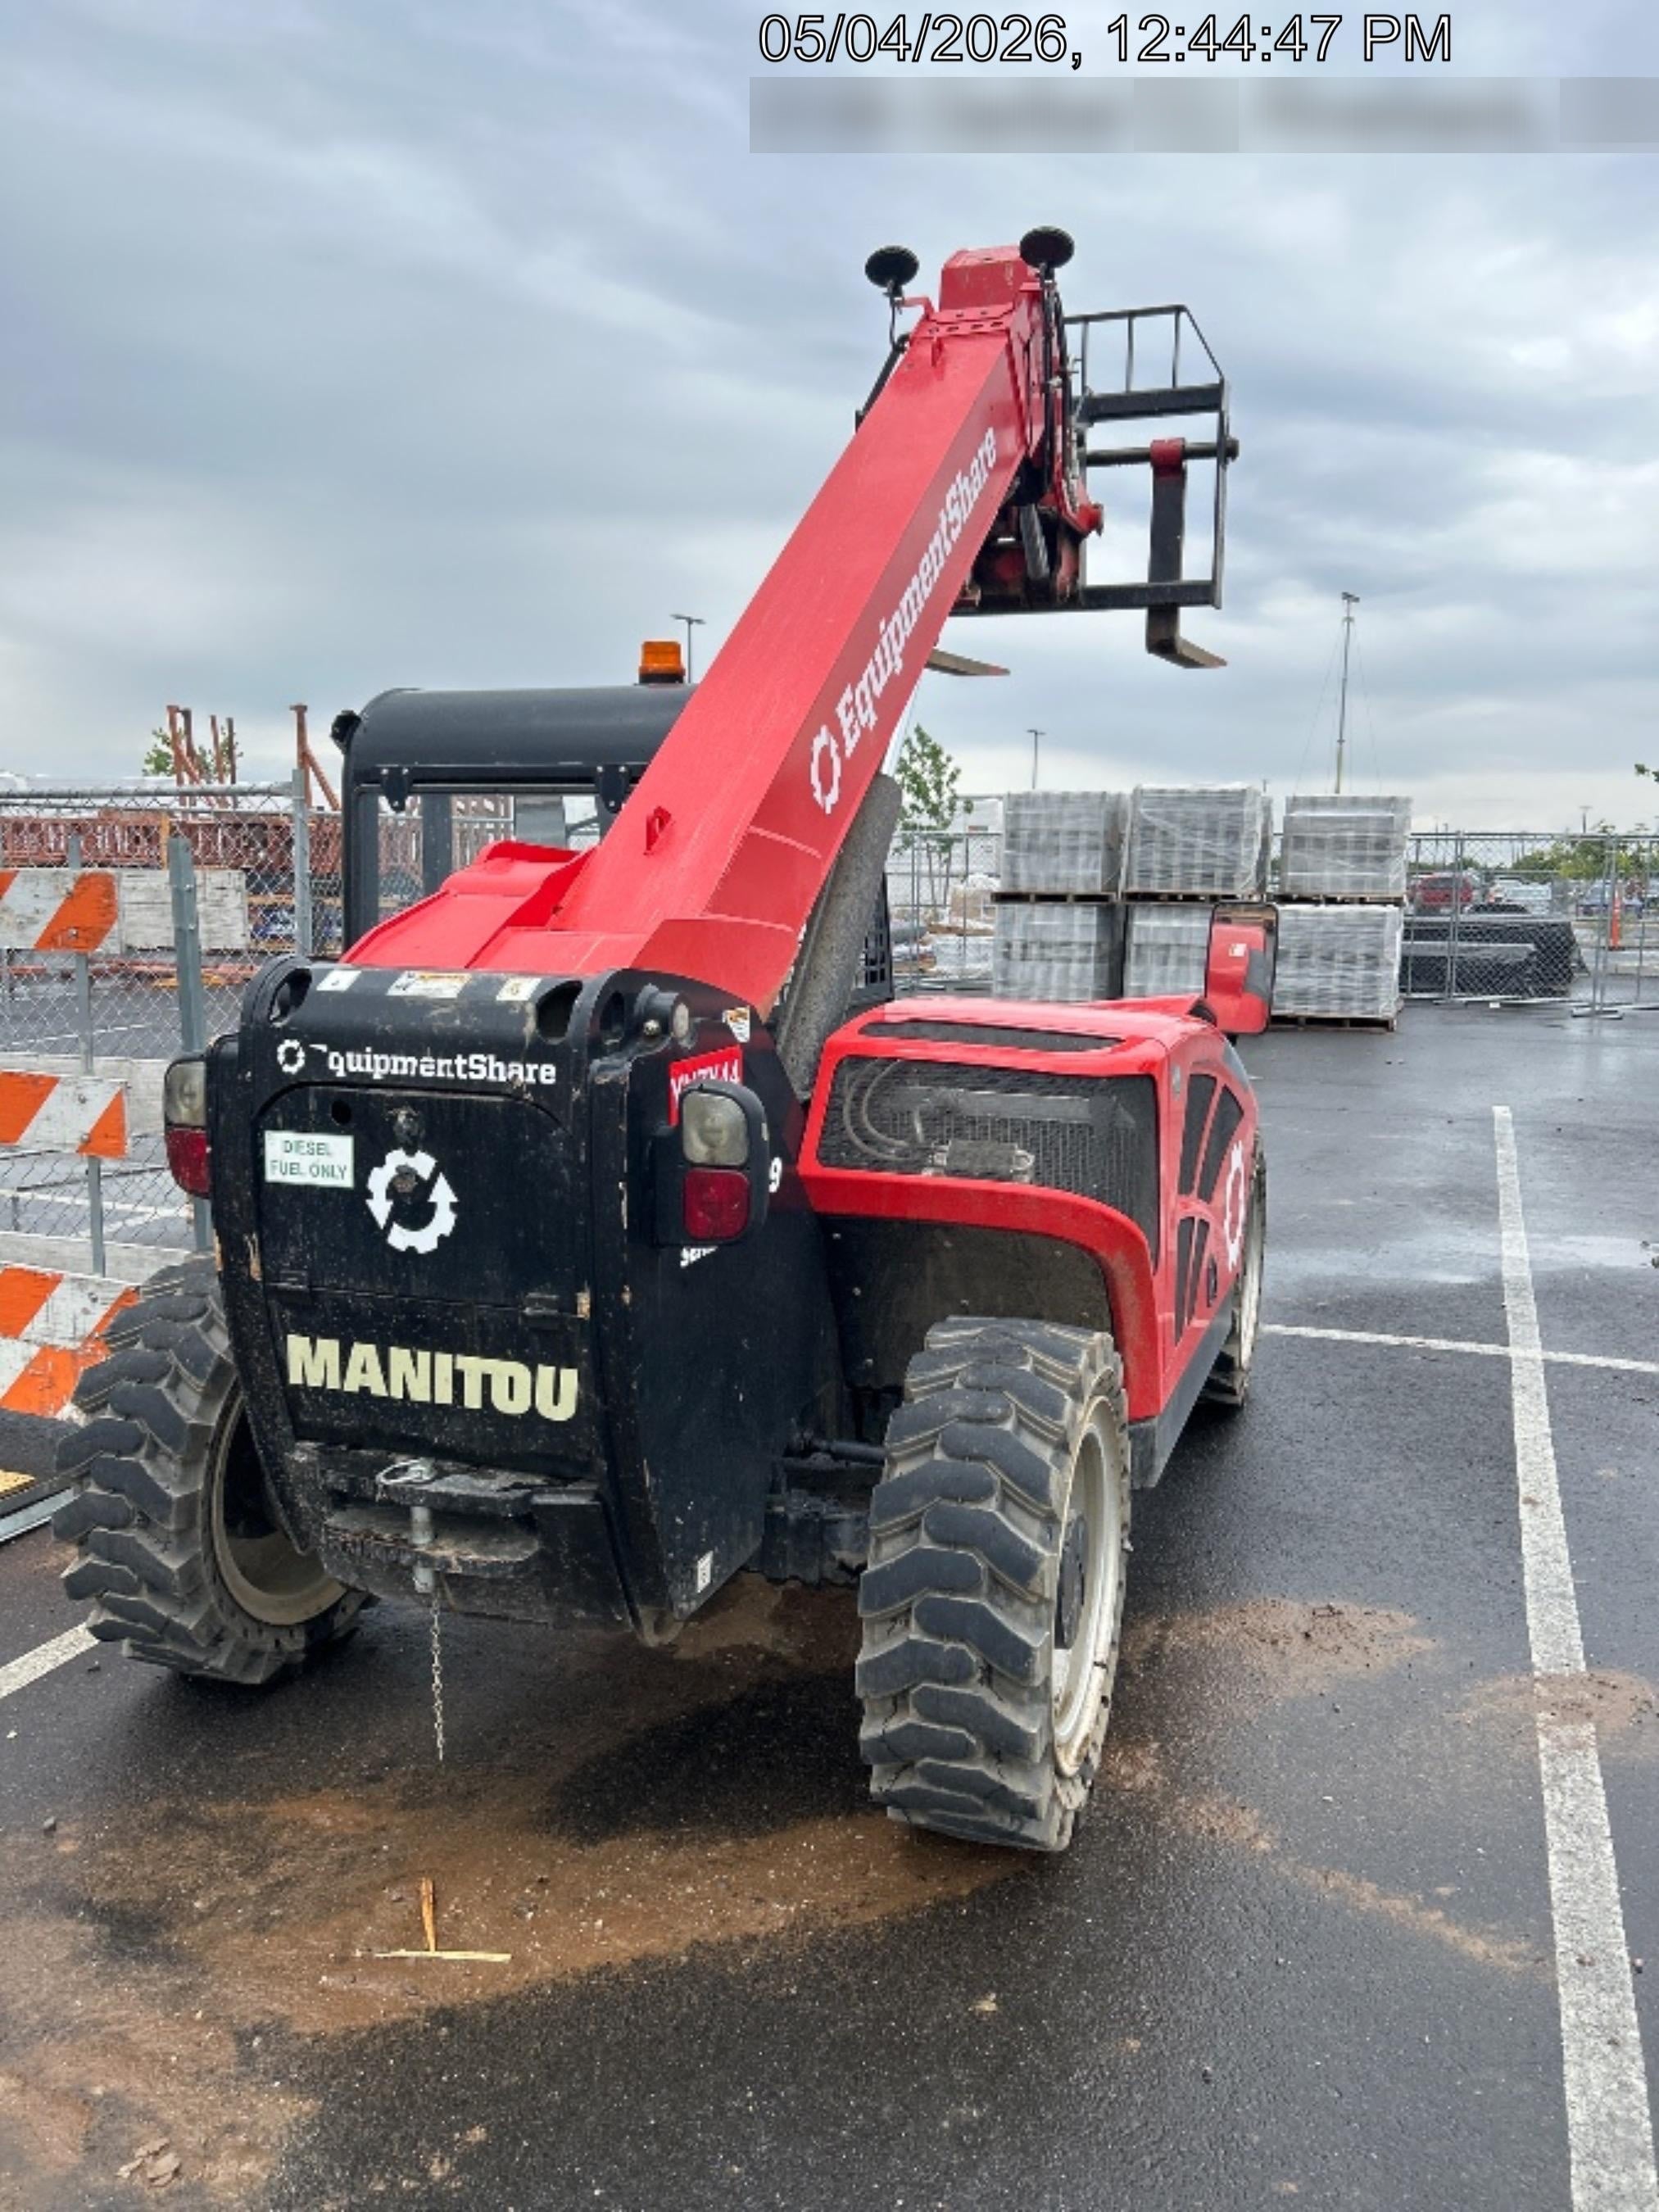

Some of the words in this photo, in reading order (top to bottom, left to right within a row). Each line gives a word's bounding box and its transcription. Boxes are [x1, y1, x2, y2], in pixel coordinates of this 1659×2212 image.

[836, 426, 998, 759] EquipmentShare
[309, 1044, 557, 1086] quipmentShare
[283, 1140, 332, 1156] DIESEL
[270, 1160, 306, 1176] FUEL
[309, 1163, 347, 1180] ONLY
[286, 1334, 578, 1421] MANITOU
